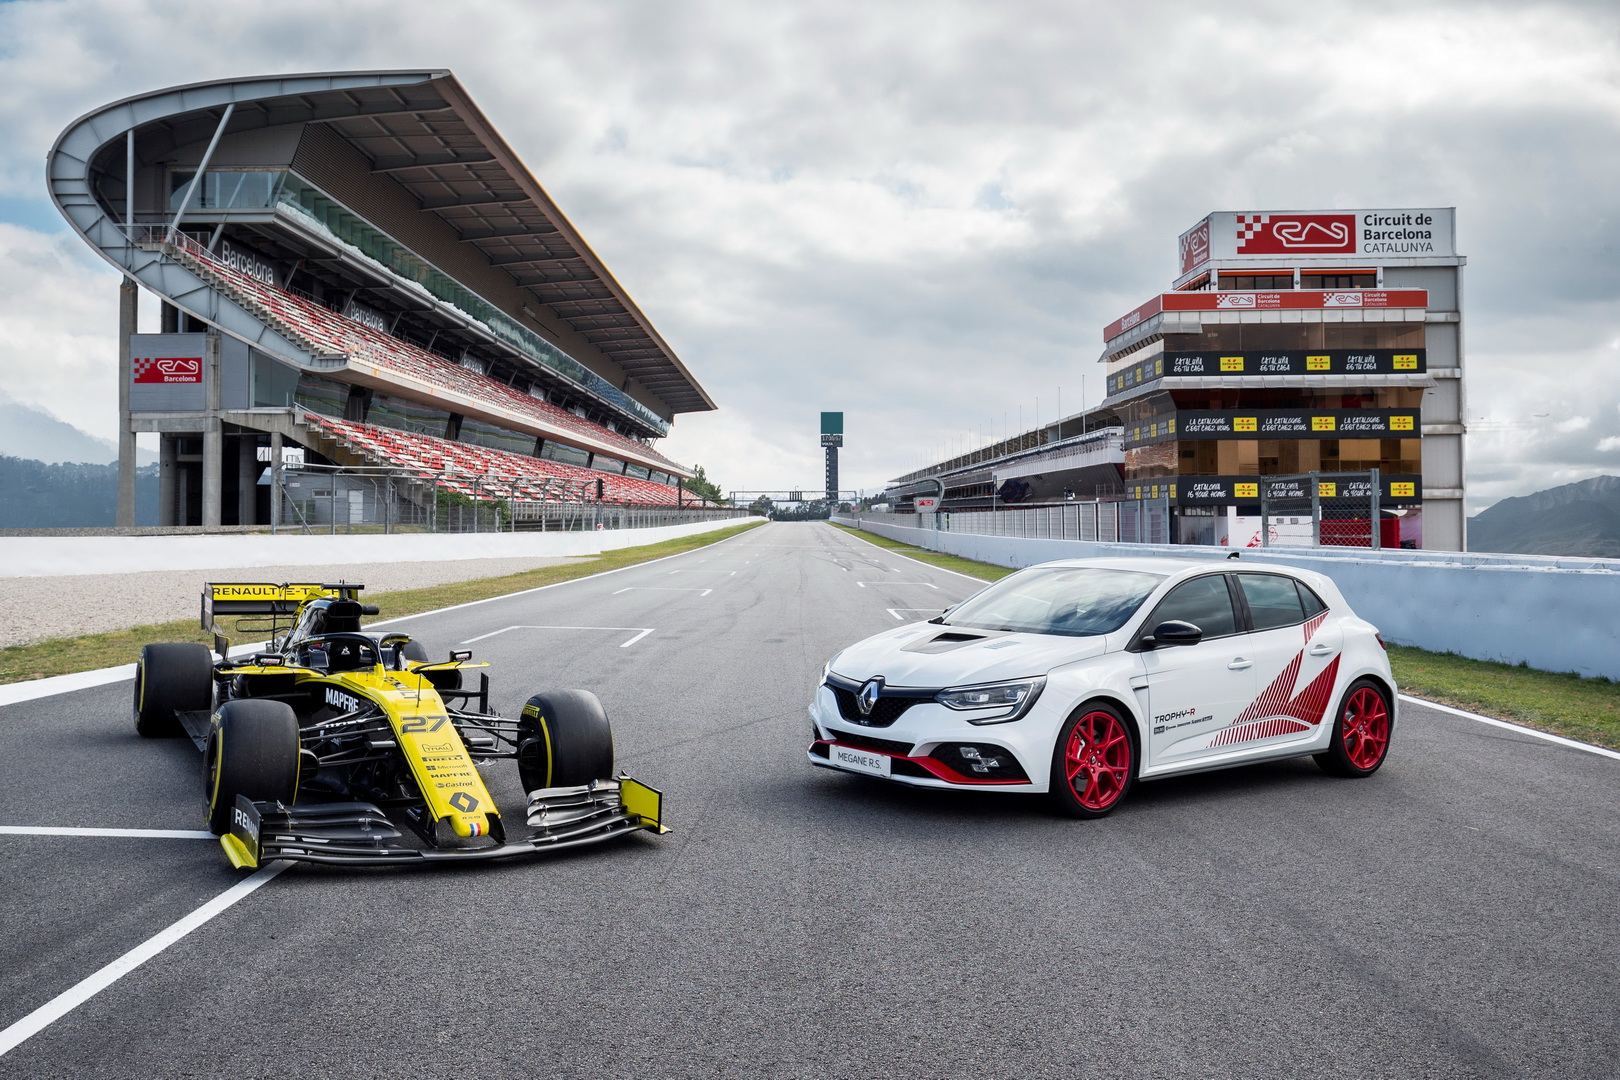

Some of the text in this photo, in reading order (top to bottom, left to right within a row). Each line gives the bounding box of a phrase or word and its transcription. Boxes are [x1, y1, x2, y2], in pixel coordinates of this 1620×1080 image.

[1363, 213, 1433, 226] Circuit de
[1363, 228, 1432, 240] Barcelona
[1363, 242, 1434, 253] CATALUNYA
[222, 240, 274, 285] Barcelona
[350, 300, 384, 331] Barcelona
[1121, 311, 1140, 331] Barcelona
[212, 587, 276, 596] RENAULT
[325, 687, 359, 713] MAPFRE
[401, 714, 449, 735] 27
[1154, 708, 1196, 724] TROPHY-R
[837, 751, 882, 770] MEGANE R.S.
